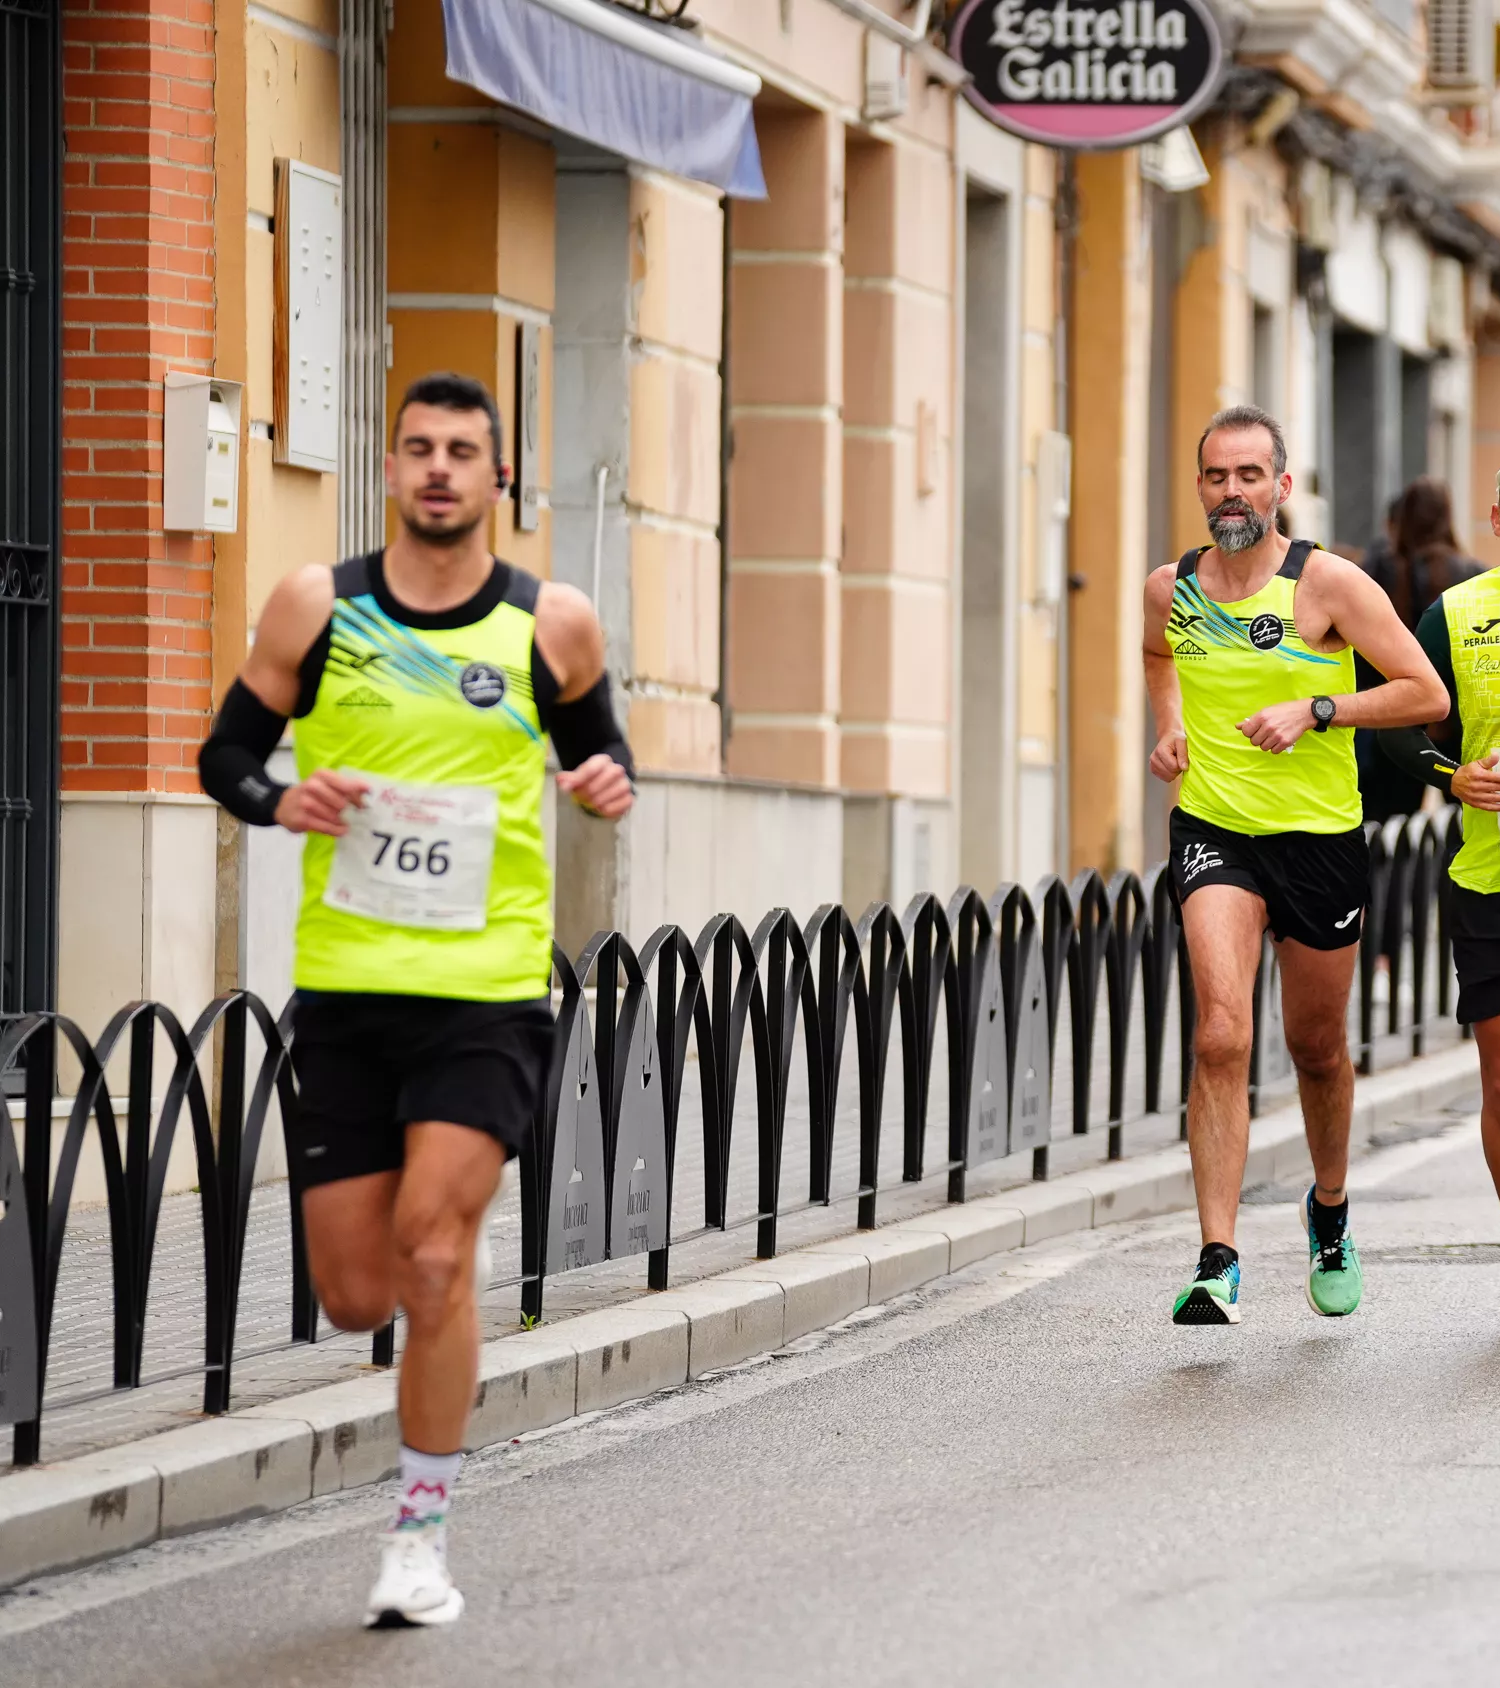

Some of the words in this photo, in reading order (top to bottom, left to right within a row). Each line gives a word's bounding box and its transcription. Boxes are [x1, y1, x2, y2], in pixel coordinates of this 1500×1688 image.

[988, 0, 1188, 48] Estrella
[998, 46, 1178, 100] Galicia
[371, 831, 450, 876] 766
